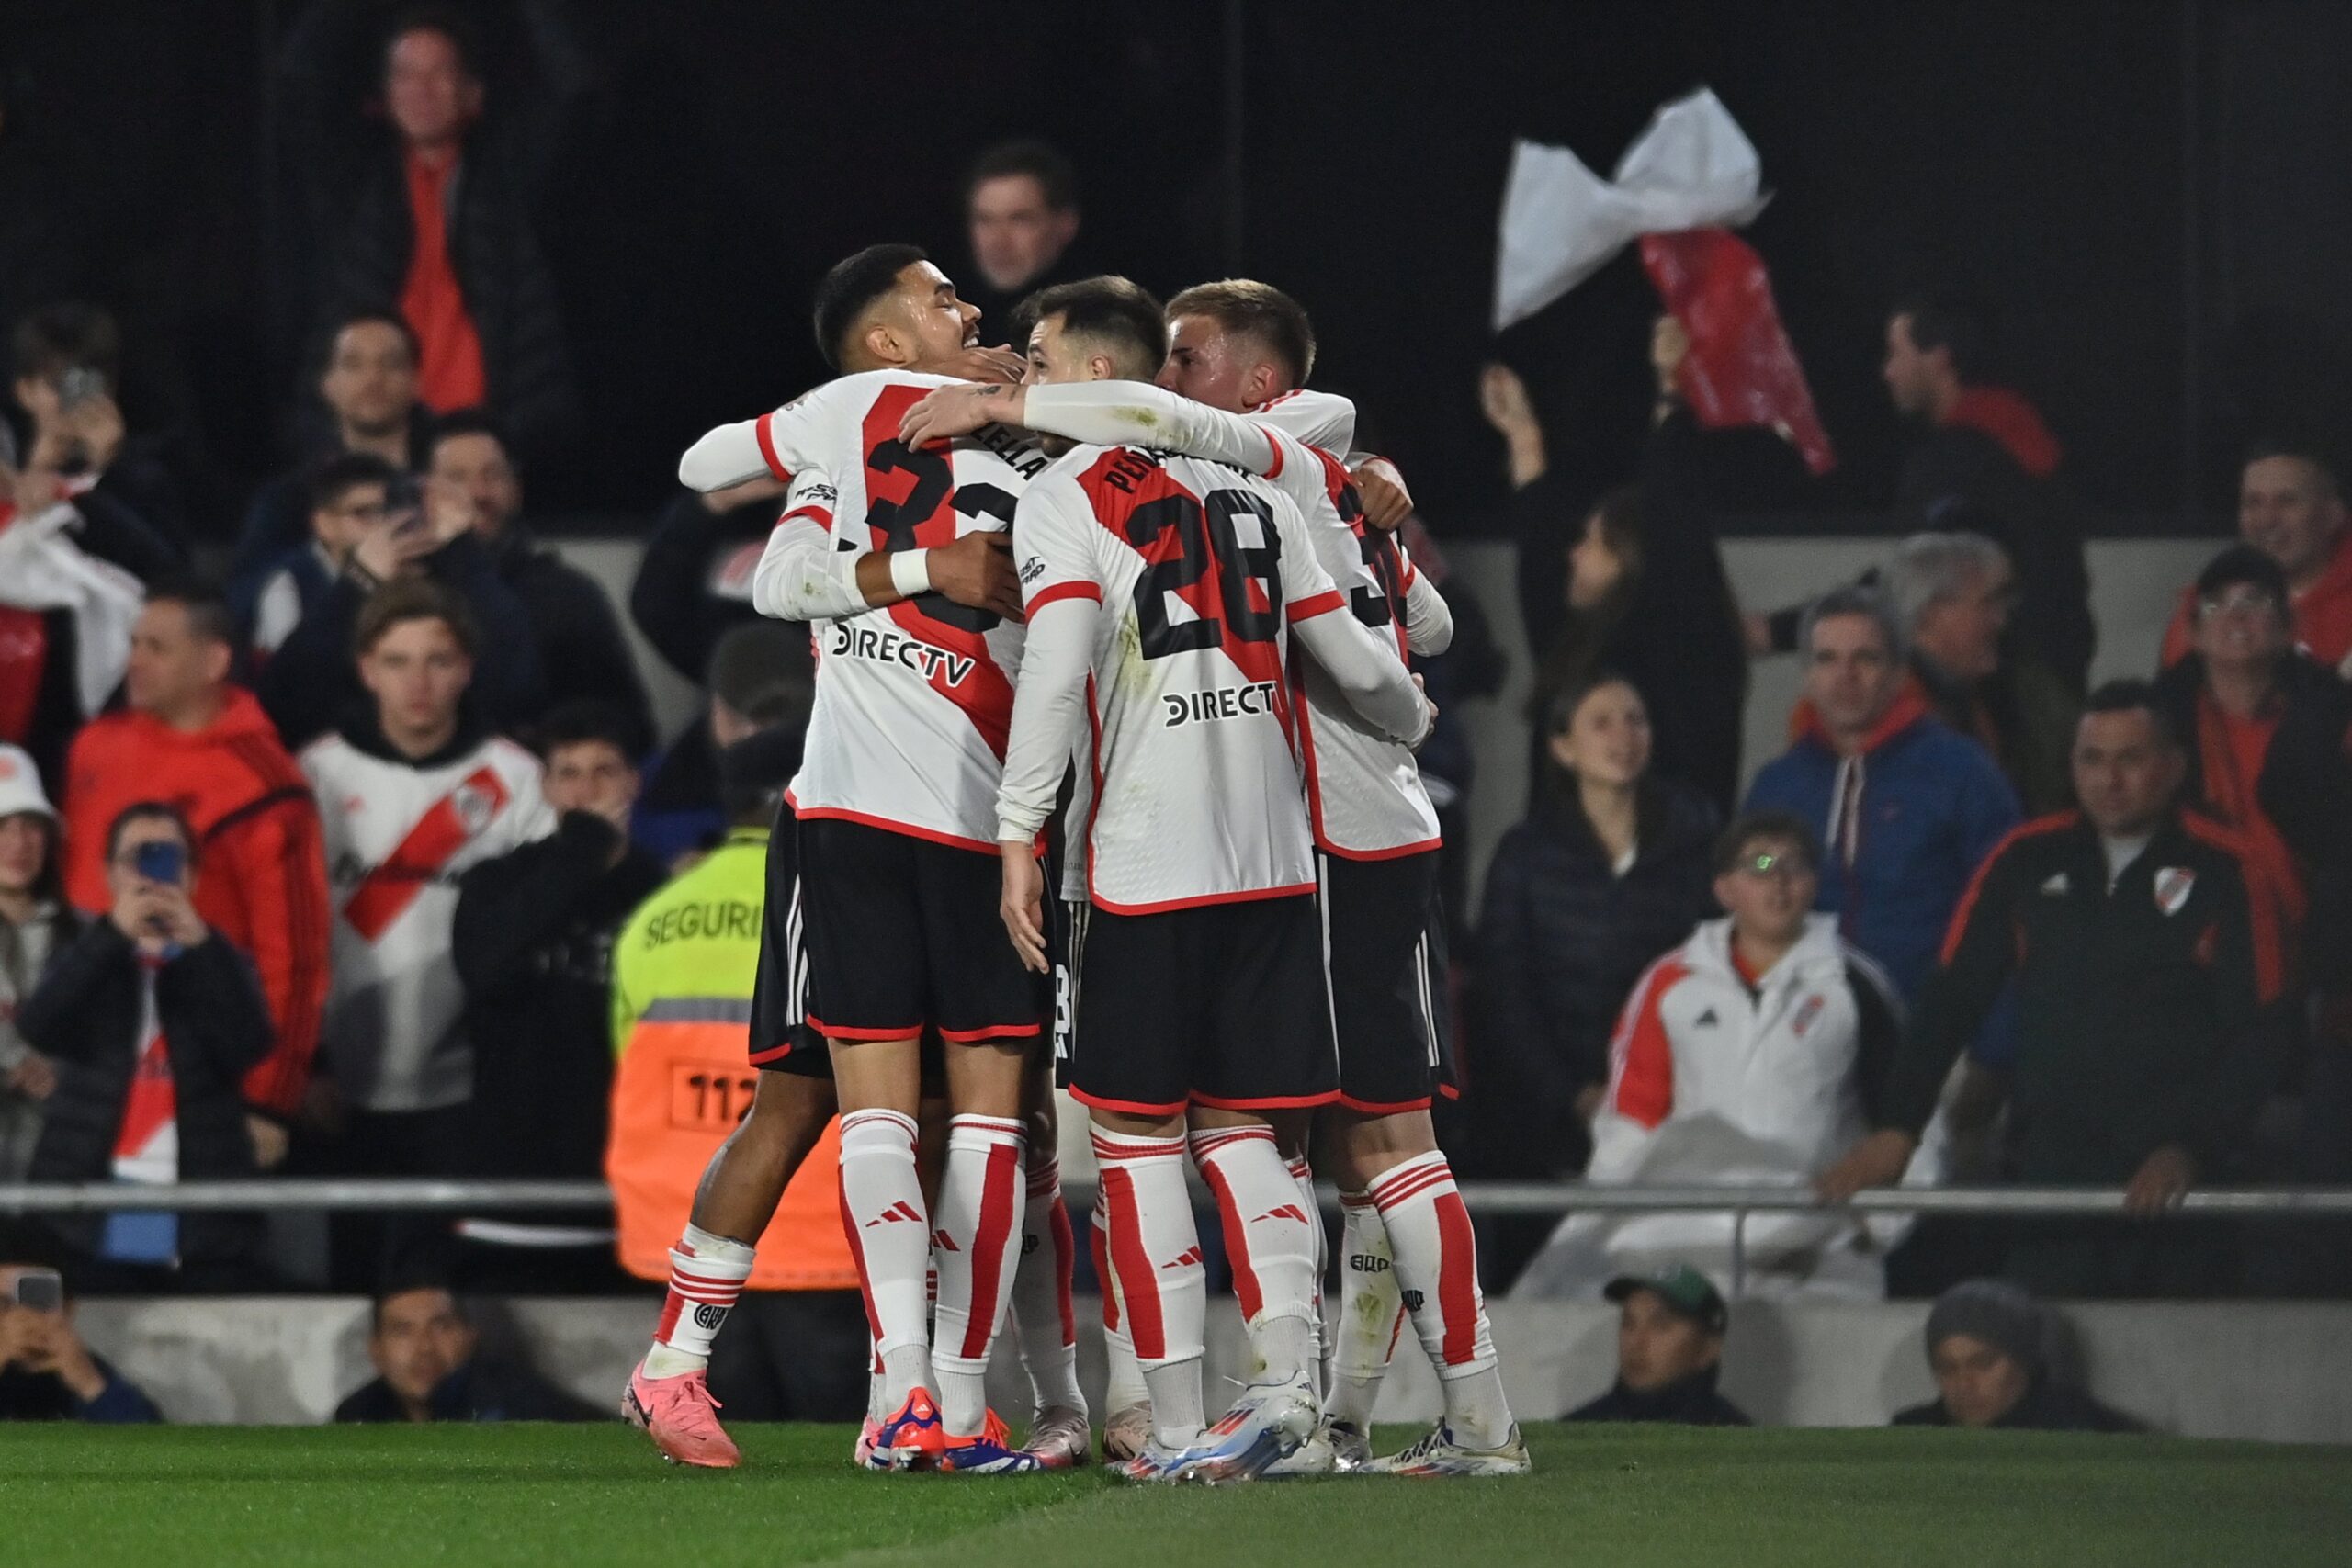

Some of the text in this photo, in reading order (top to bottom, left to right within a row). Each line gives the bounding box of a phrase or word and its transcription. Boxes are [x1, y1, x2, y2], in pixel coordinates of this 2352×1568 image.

[1126, 489, 1282, 660] 28
[832, 623, 973, 685] DIRECTV
[1162, 682, 1277, 728] DIRECT
[644, 900, 762, 950] SEGURI
